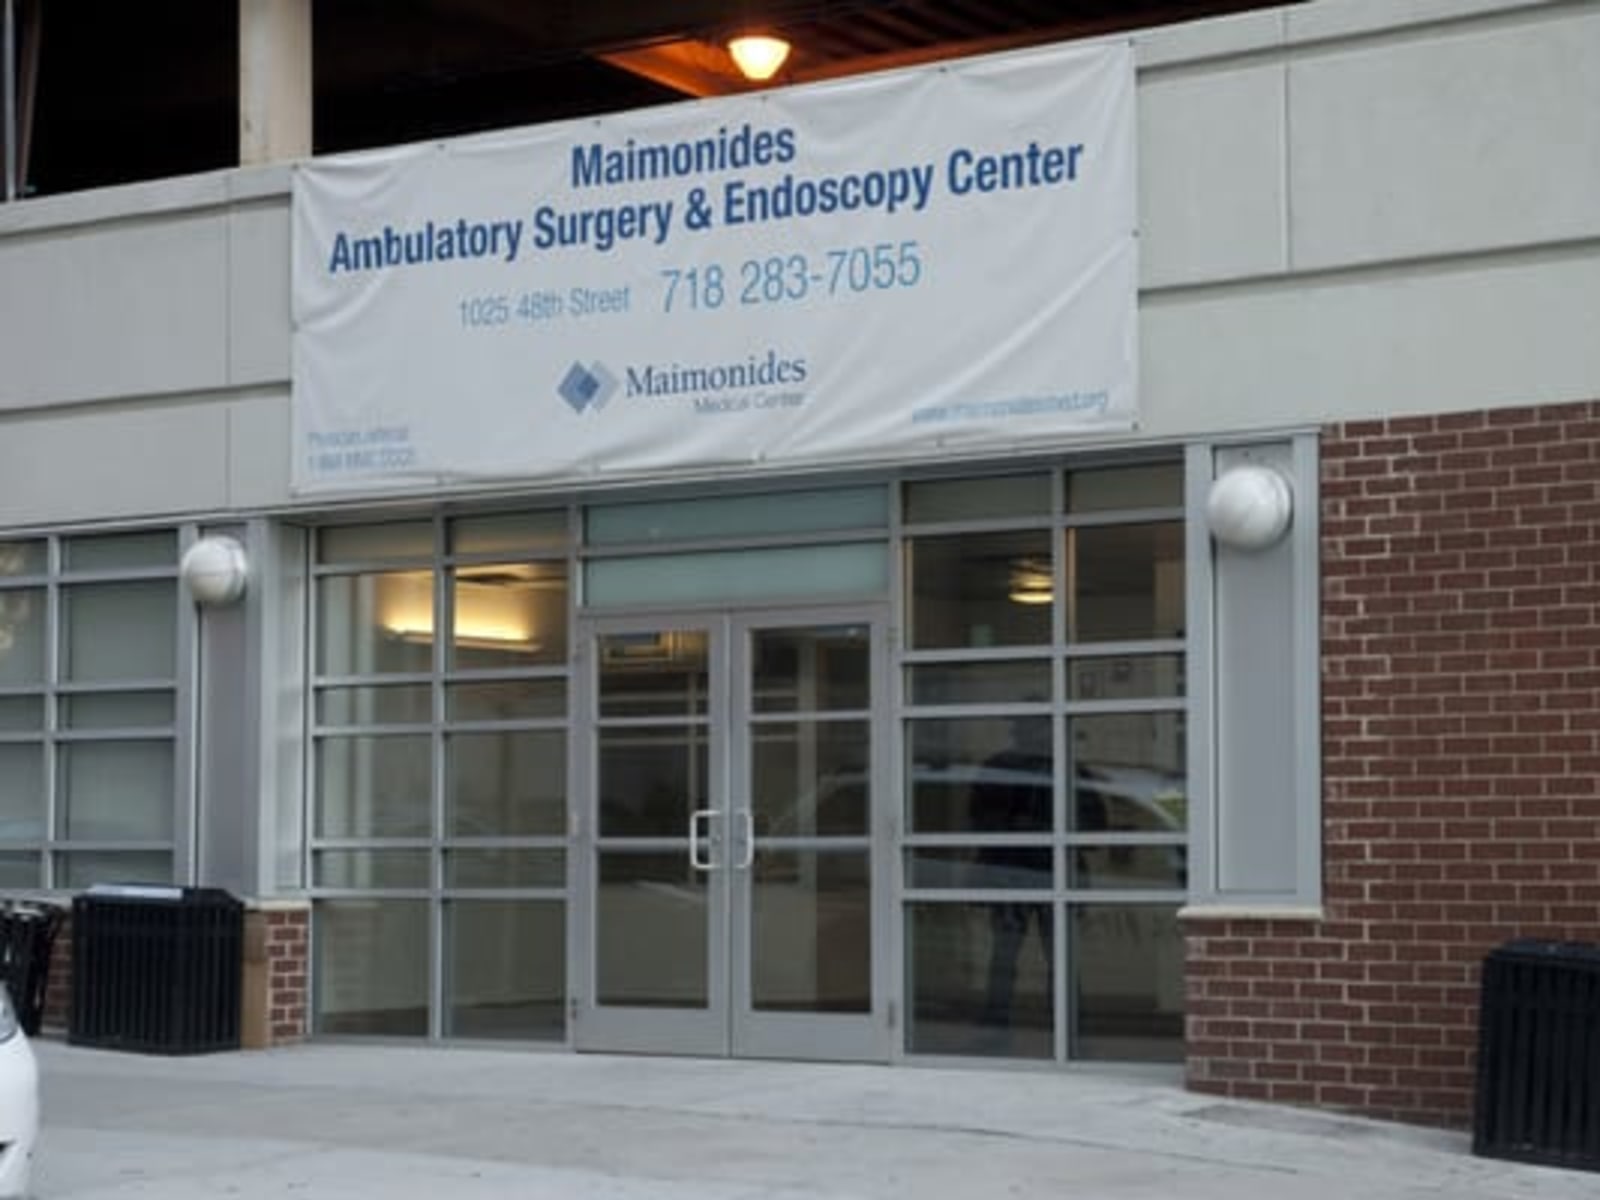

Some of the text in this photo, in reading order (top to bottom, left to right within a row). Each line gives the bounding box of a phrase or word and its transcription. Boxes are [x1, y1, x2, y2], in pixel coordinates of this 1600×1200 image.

[571, 123, 795, 188] Maimonides
[329, 141, 1084, 273] Ambulatory Surgery & Endoscopy Center
[459, 297, 509, 328] 1025
[569, 286, 631, 316] Street
[661, 264, 724, 314] 718
[739, 240, 921, 305] 283-7055
[626, 350, 807, 398] Maimonides
